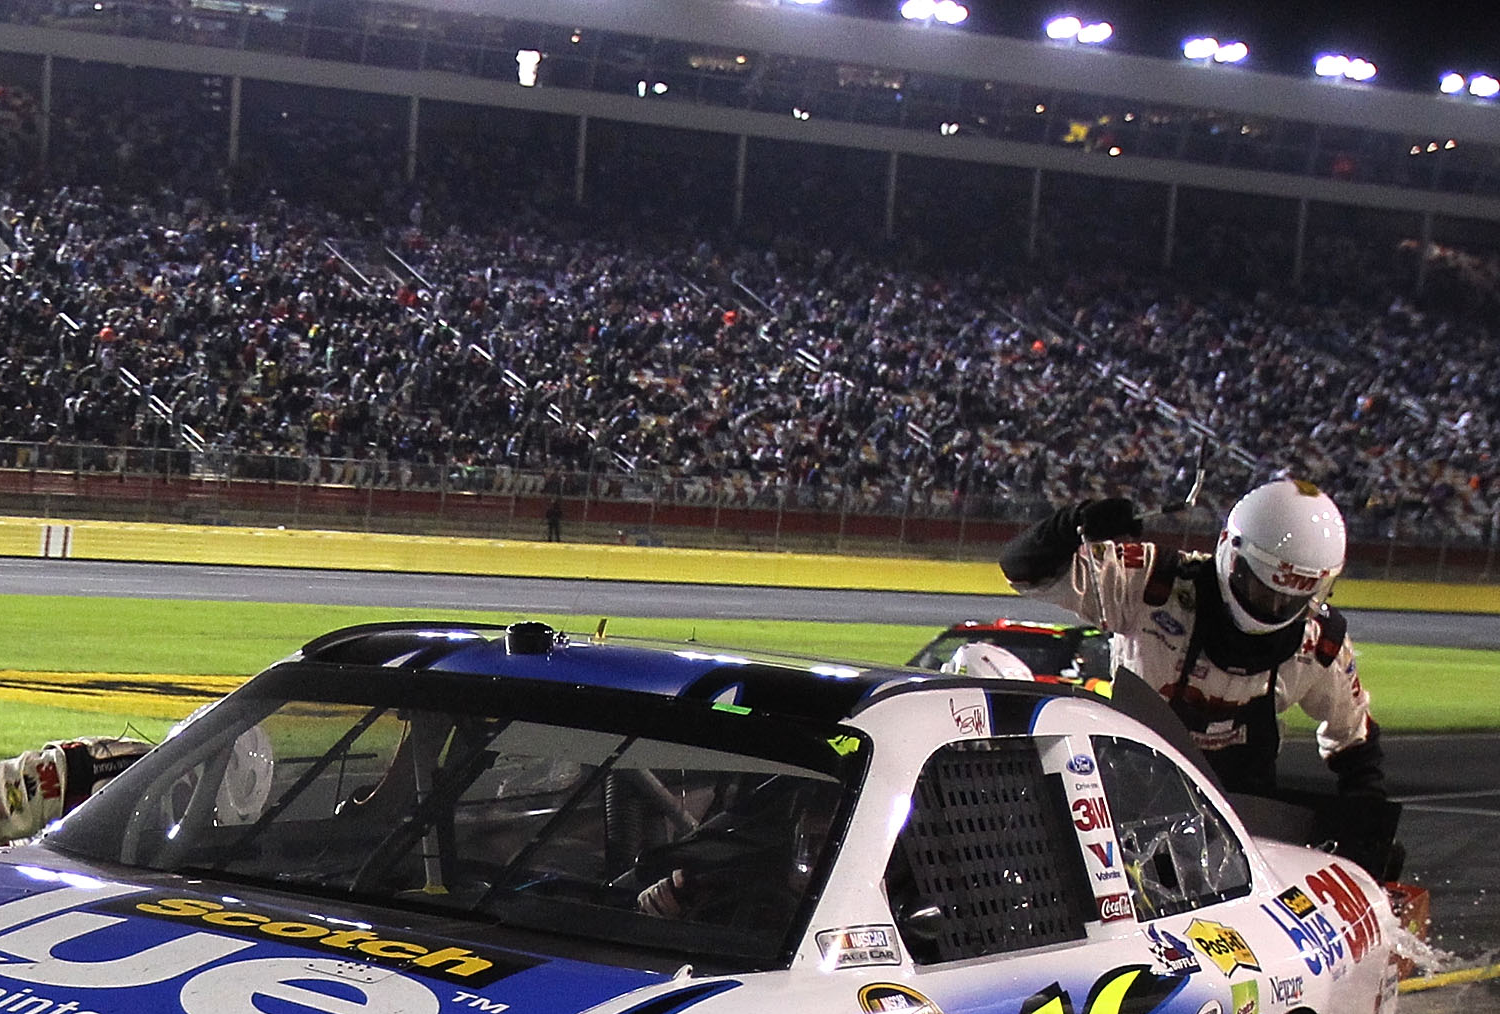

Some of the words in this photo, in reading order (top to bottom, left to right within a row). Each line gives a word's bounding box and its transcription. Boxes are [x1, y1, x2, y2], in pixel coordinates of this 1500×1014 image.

[1072, 797, 1111, 832] 3M
[1305, 863, 1382, 964] 3M
[850, 931, 887, 947] NASCAR
[1194, 930, 1246, 957] Post-it
[1260, 898, 1344, 977] blue
[880, 993, 909, 1012] NASCAR
